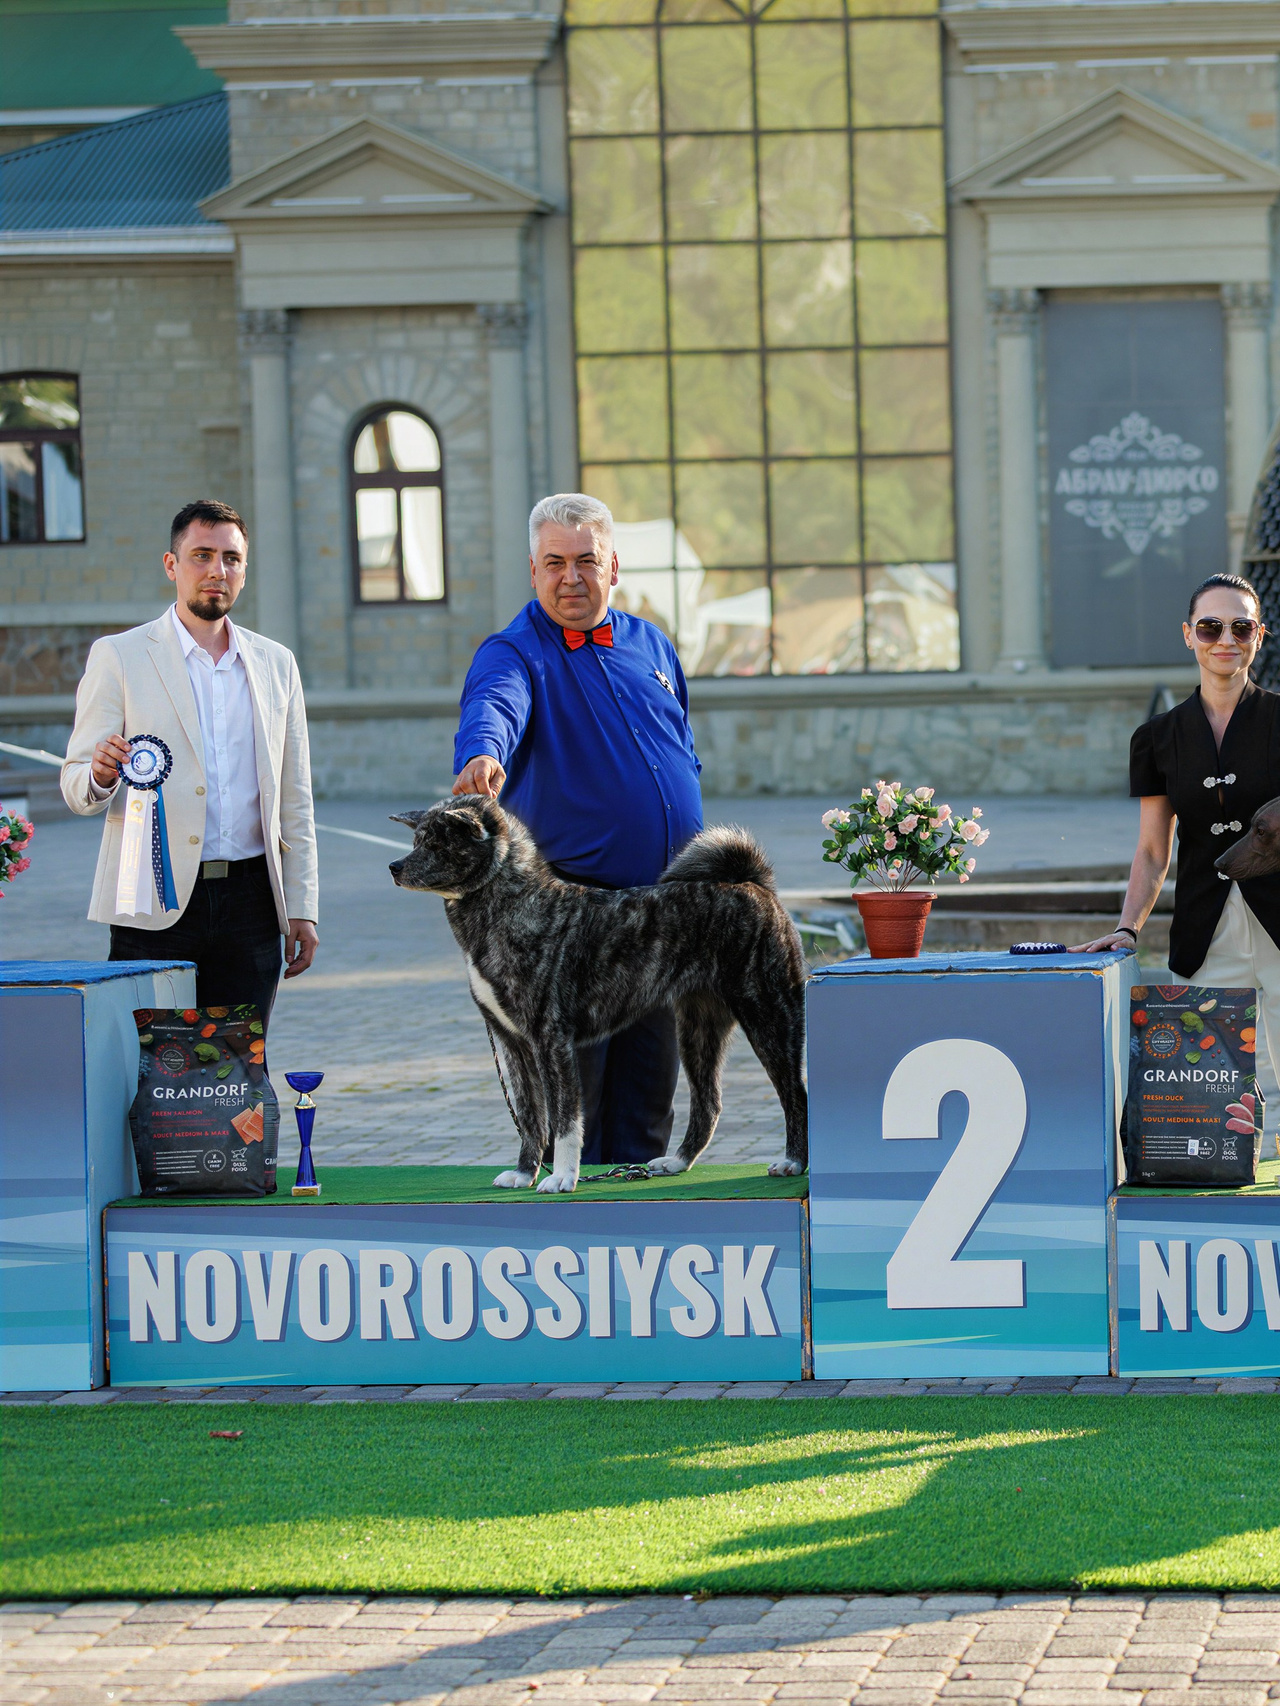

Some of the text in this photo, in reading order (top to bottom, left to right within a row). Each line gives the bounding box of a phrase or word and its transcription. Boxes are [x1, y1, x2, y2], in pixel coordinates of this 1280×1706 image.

[1055, 465, 1219, 496] АБРАУ-ДЮРСО
[1144, 1069, 1239, 1082] GRANDORF
[152, 1082, 248, 1100] GRANDORF
[1206, 1084, 1234, 1093] FRESH
[214, 1098, 244, 1107] FRESH
[882, 1038, 1027, 1309] 2
[127, 1245, 781, 1344] NOVOROSSIYSK
